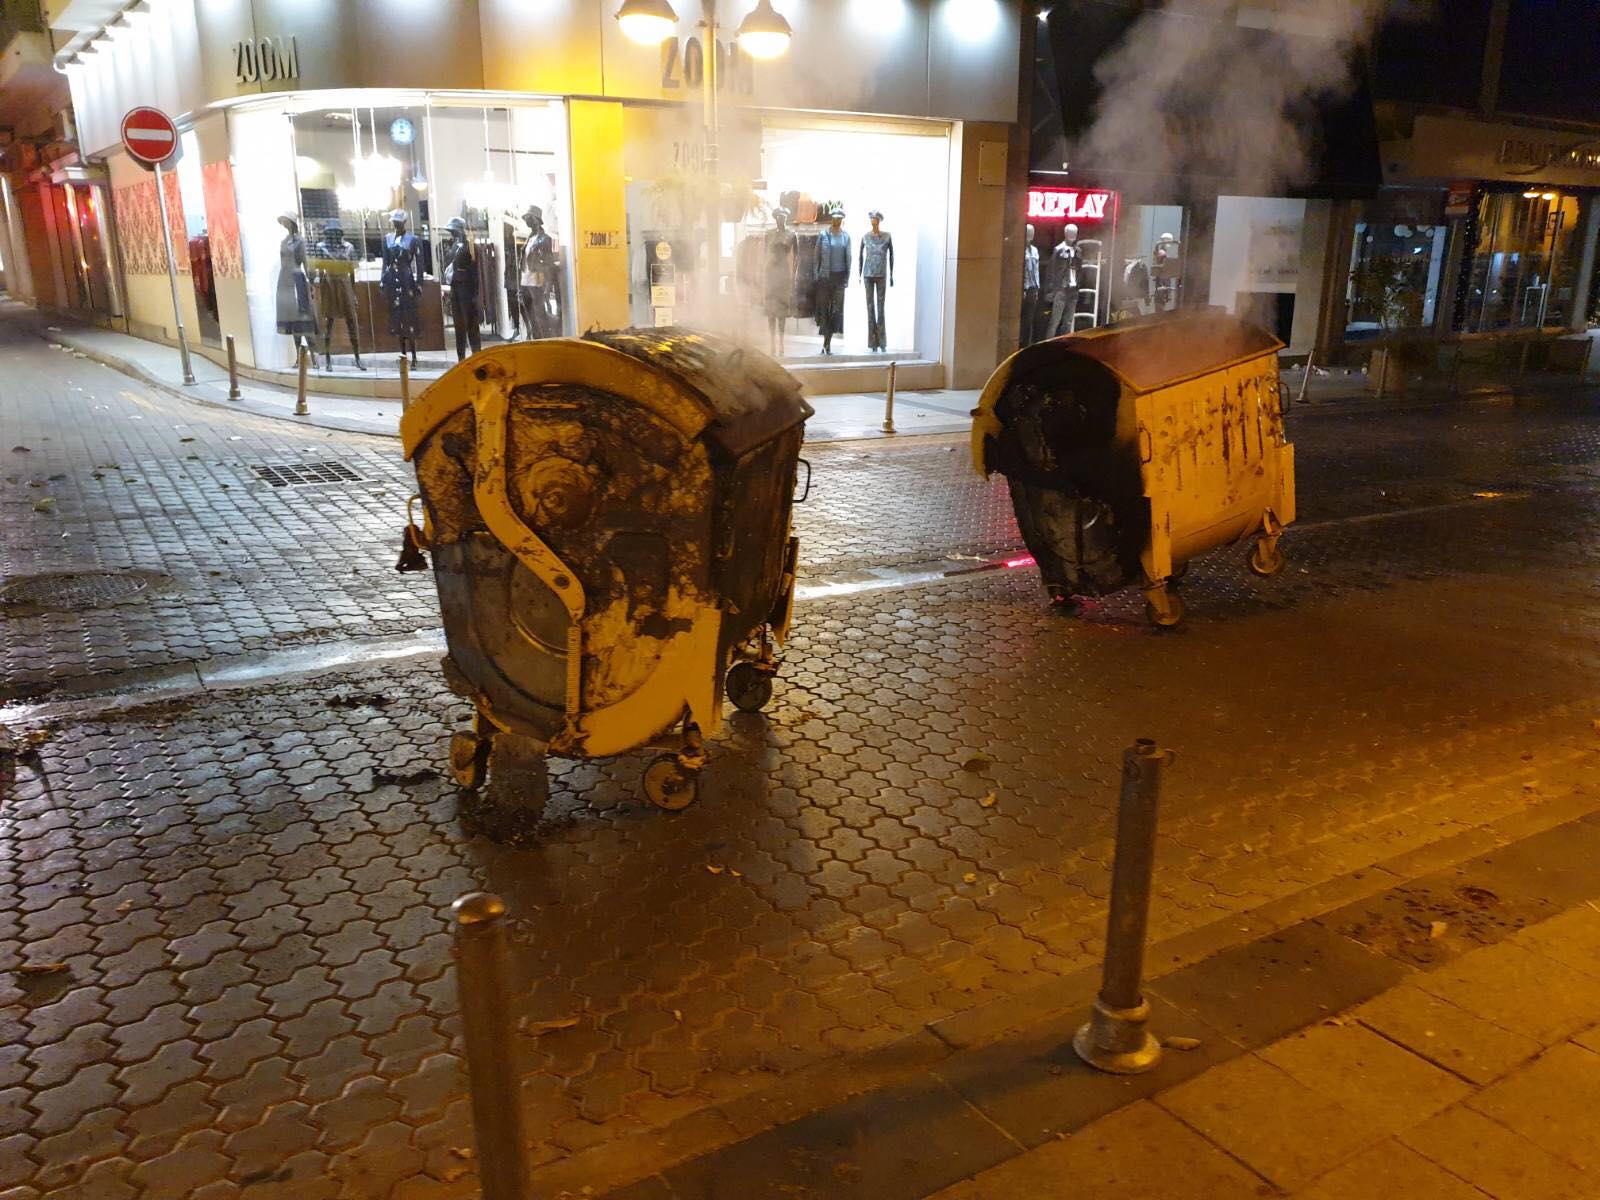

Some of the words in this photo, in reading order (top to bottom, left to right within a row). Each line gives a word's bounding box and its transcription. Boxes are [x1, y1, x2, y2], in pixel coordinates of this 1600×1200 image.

[233, 33, 300, 83] ZOOM
[1028, 191, 1109, 218] REPLAY
[590, 231, 606, 247] ZOOM
